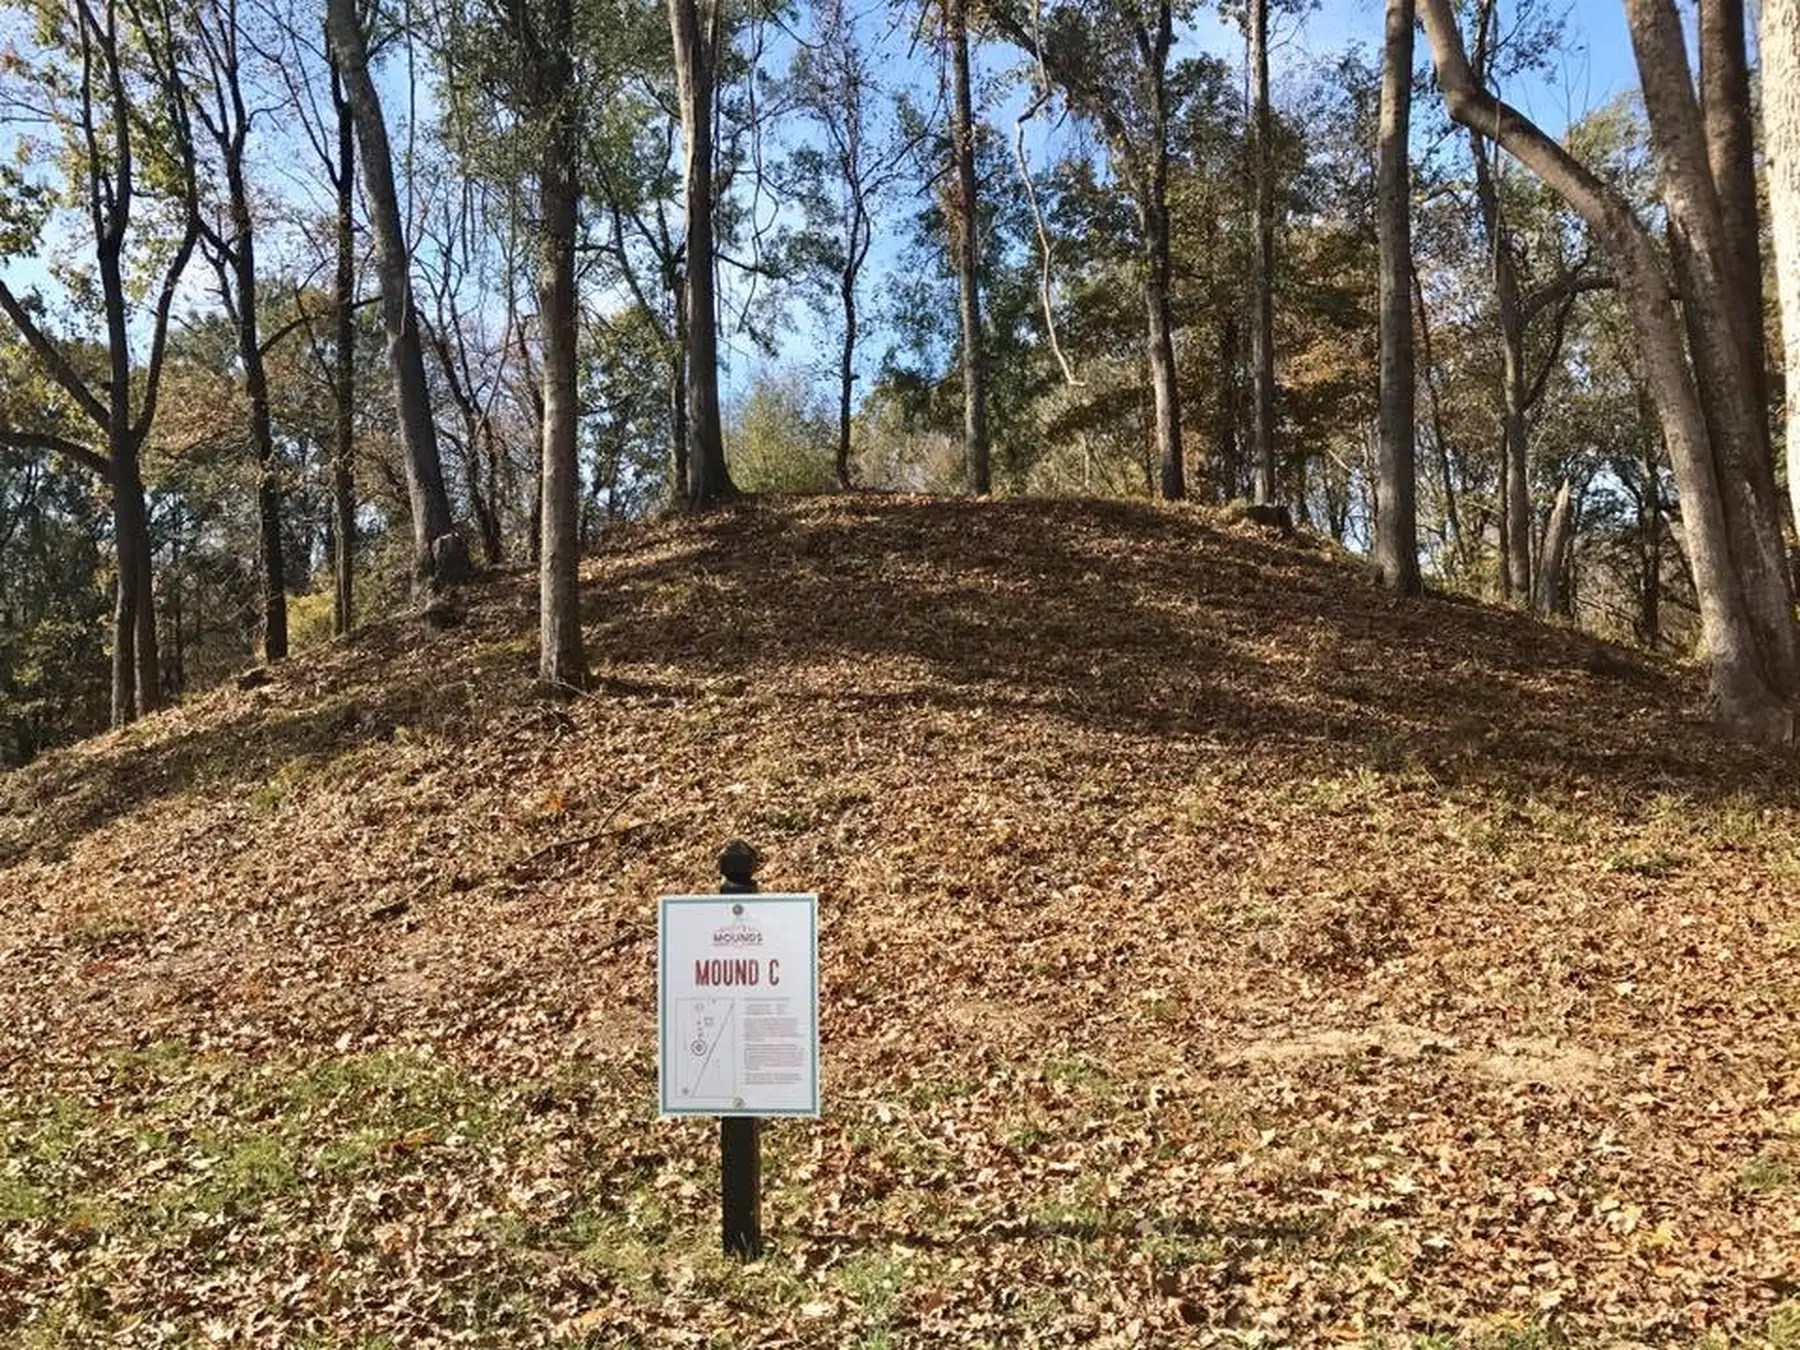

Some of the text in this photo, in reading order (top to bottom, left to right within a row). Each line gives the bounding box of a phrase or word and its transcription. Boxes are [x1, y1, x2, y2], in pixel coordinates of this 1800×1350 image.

[713, 932, 763, 943] MOUNDS
[695, 959, 780, 987] MOUND C
